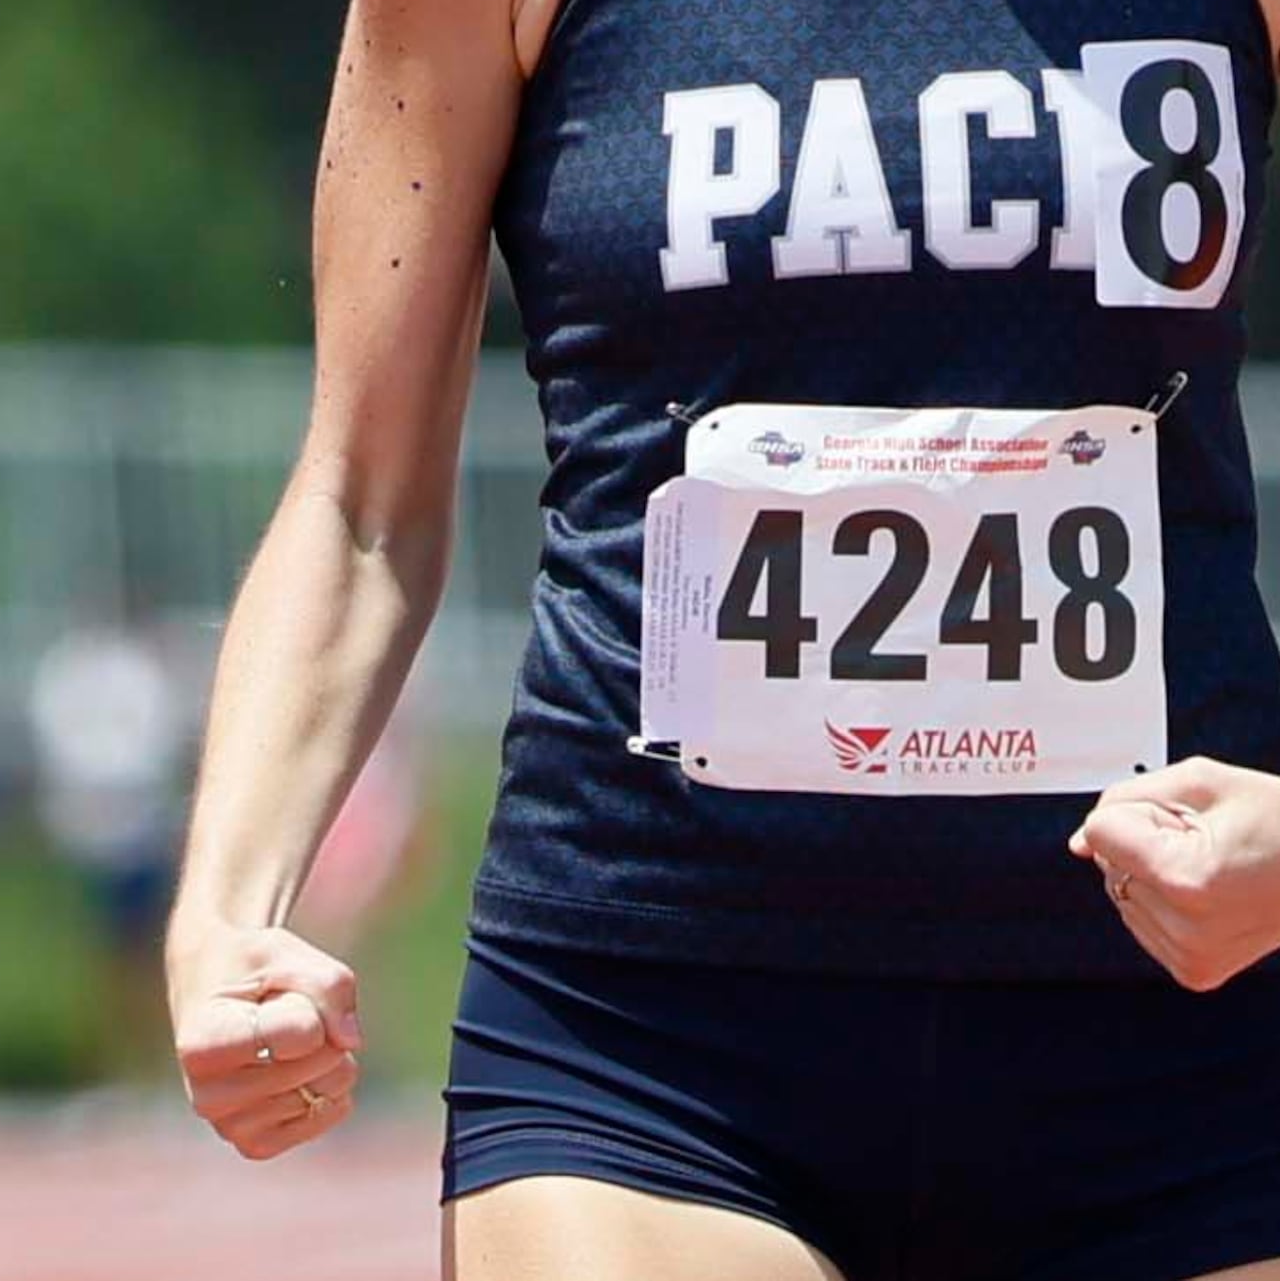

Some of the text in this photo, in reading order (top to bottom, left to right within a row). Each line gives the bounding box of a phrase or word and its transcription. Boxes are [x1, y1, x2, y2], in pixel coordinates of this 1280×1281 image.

[1120, 58, 1229, 293] 8
[823, 435, 879, 451] Georgia
[883, 436, 915, 452] High
[918, 437, 966, 452] School
[816, 455, 852, 470] State
[857, 455, 895, 471] Track
[912, 456, 946, 471] Field
[716, 506, 1137, 682] 4248
[899, 729, 1037, 758] ATLANTA
[899, 759, 1037, 774] TRACK CLUB
